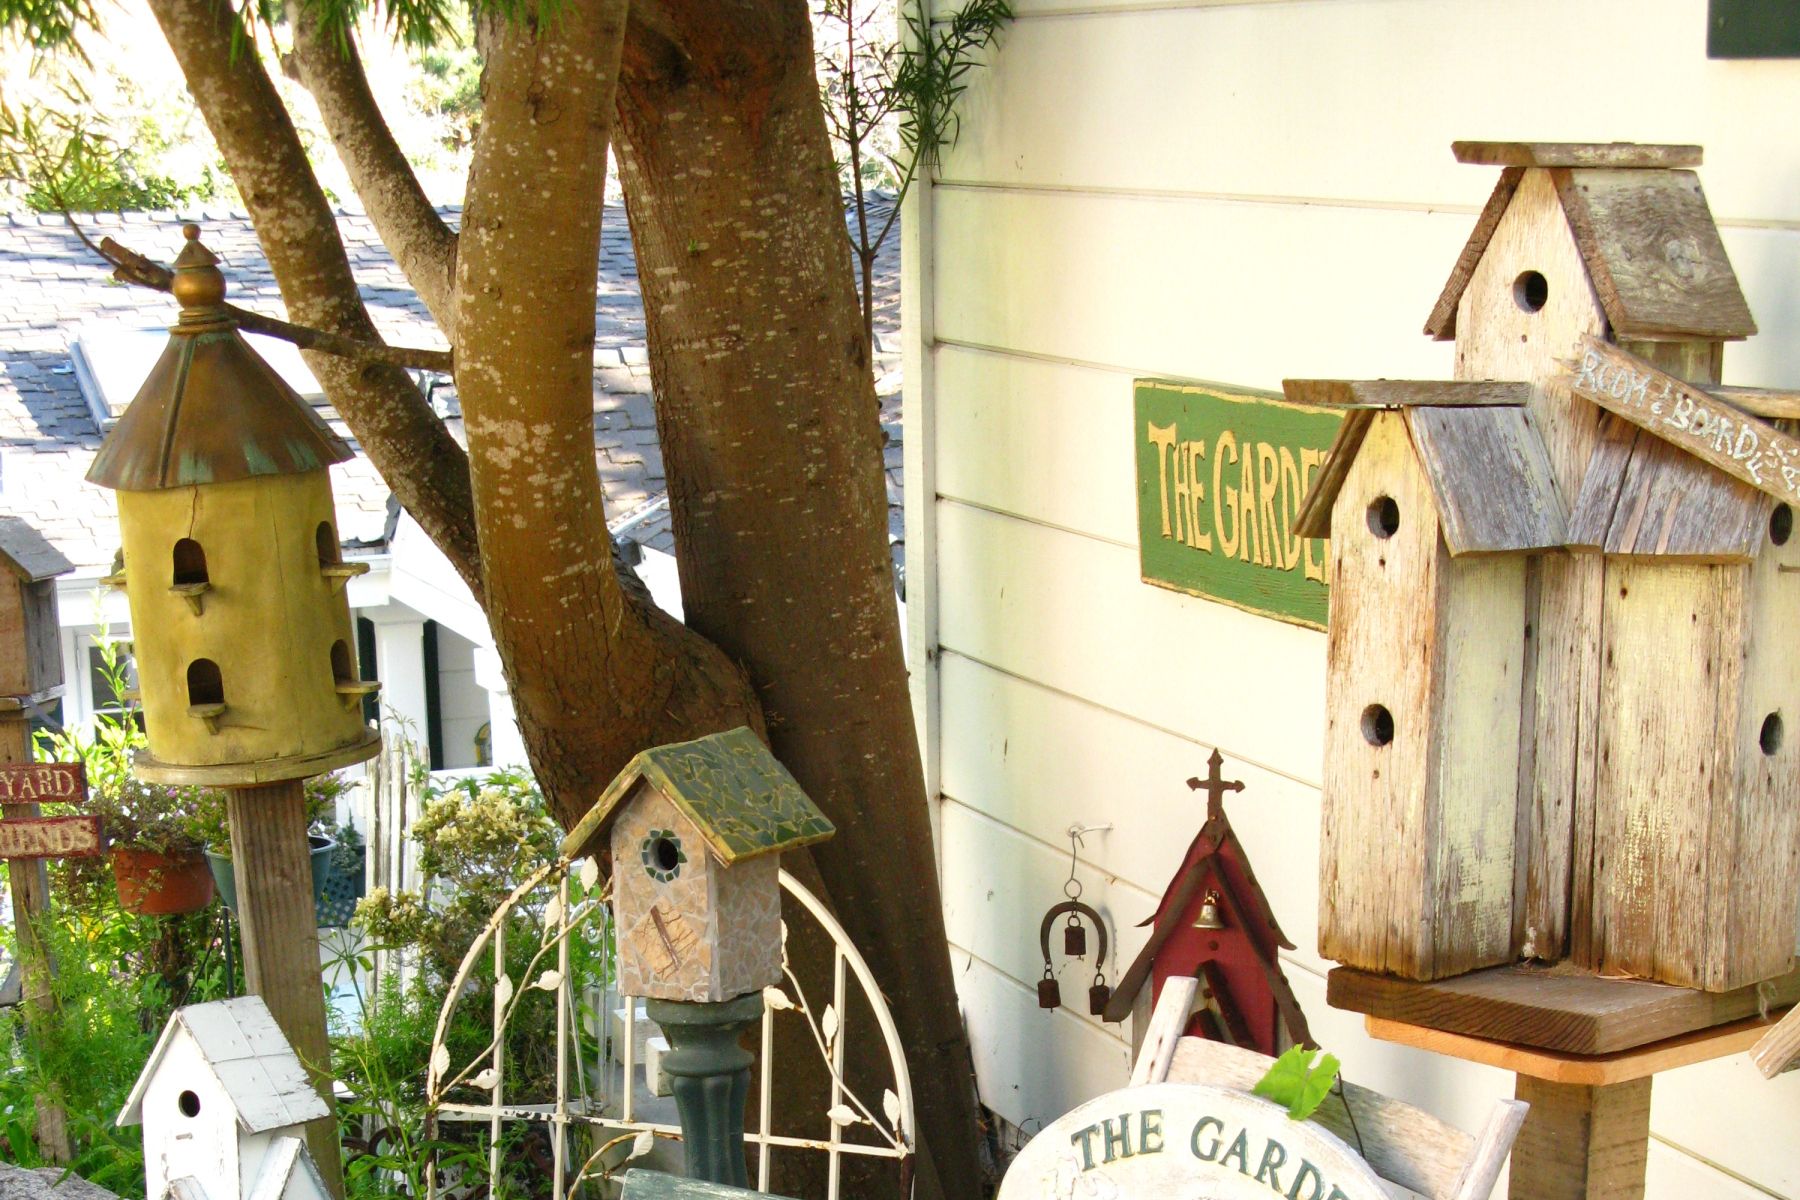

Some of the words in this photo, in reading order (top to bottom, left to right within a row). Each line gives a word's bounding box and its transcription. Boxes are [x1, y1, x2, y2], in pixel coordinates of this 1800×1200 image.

[1662, 392, 1759, 460] BOARD
[1148, 420, 1212, 555] THE
[0, 820, 93, 857] IENDS
[1071, 1109, 1164, 1172] THE
